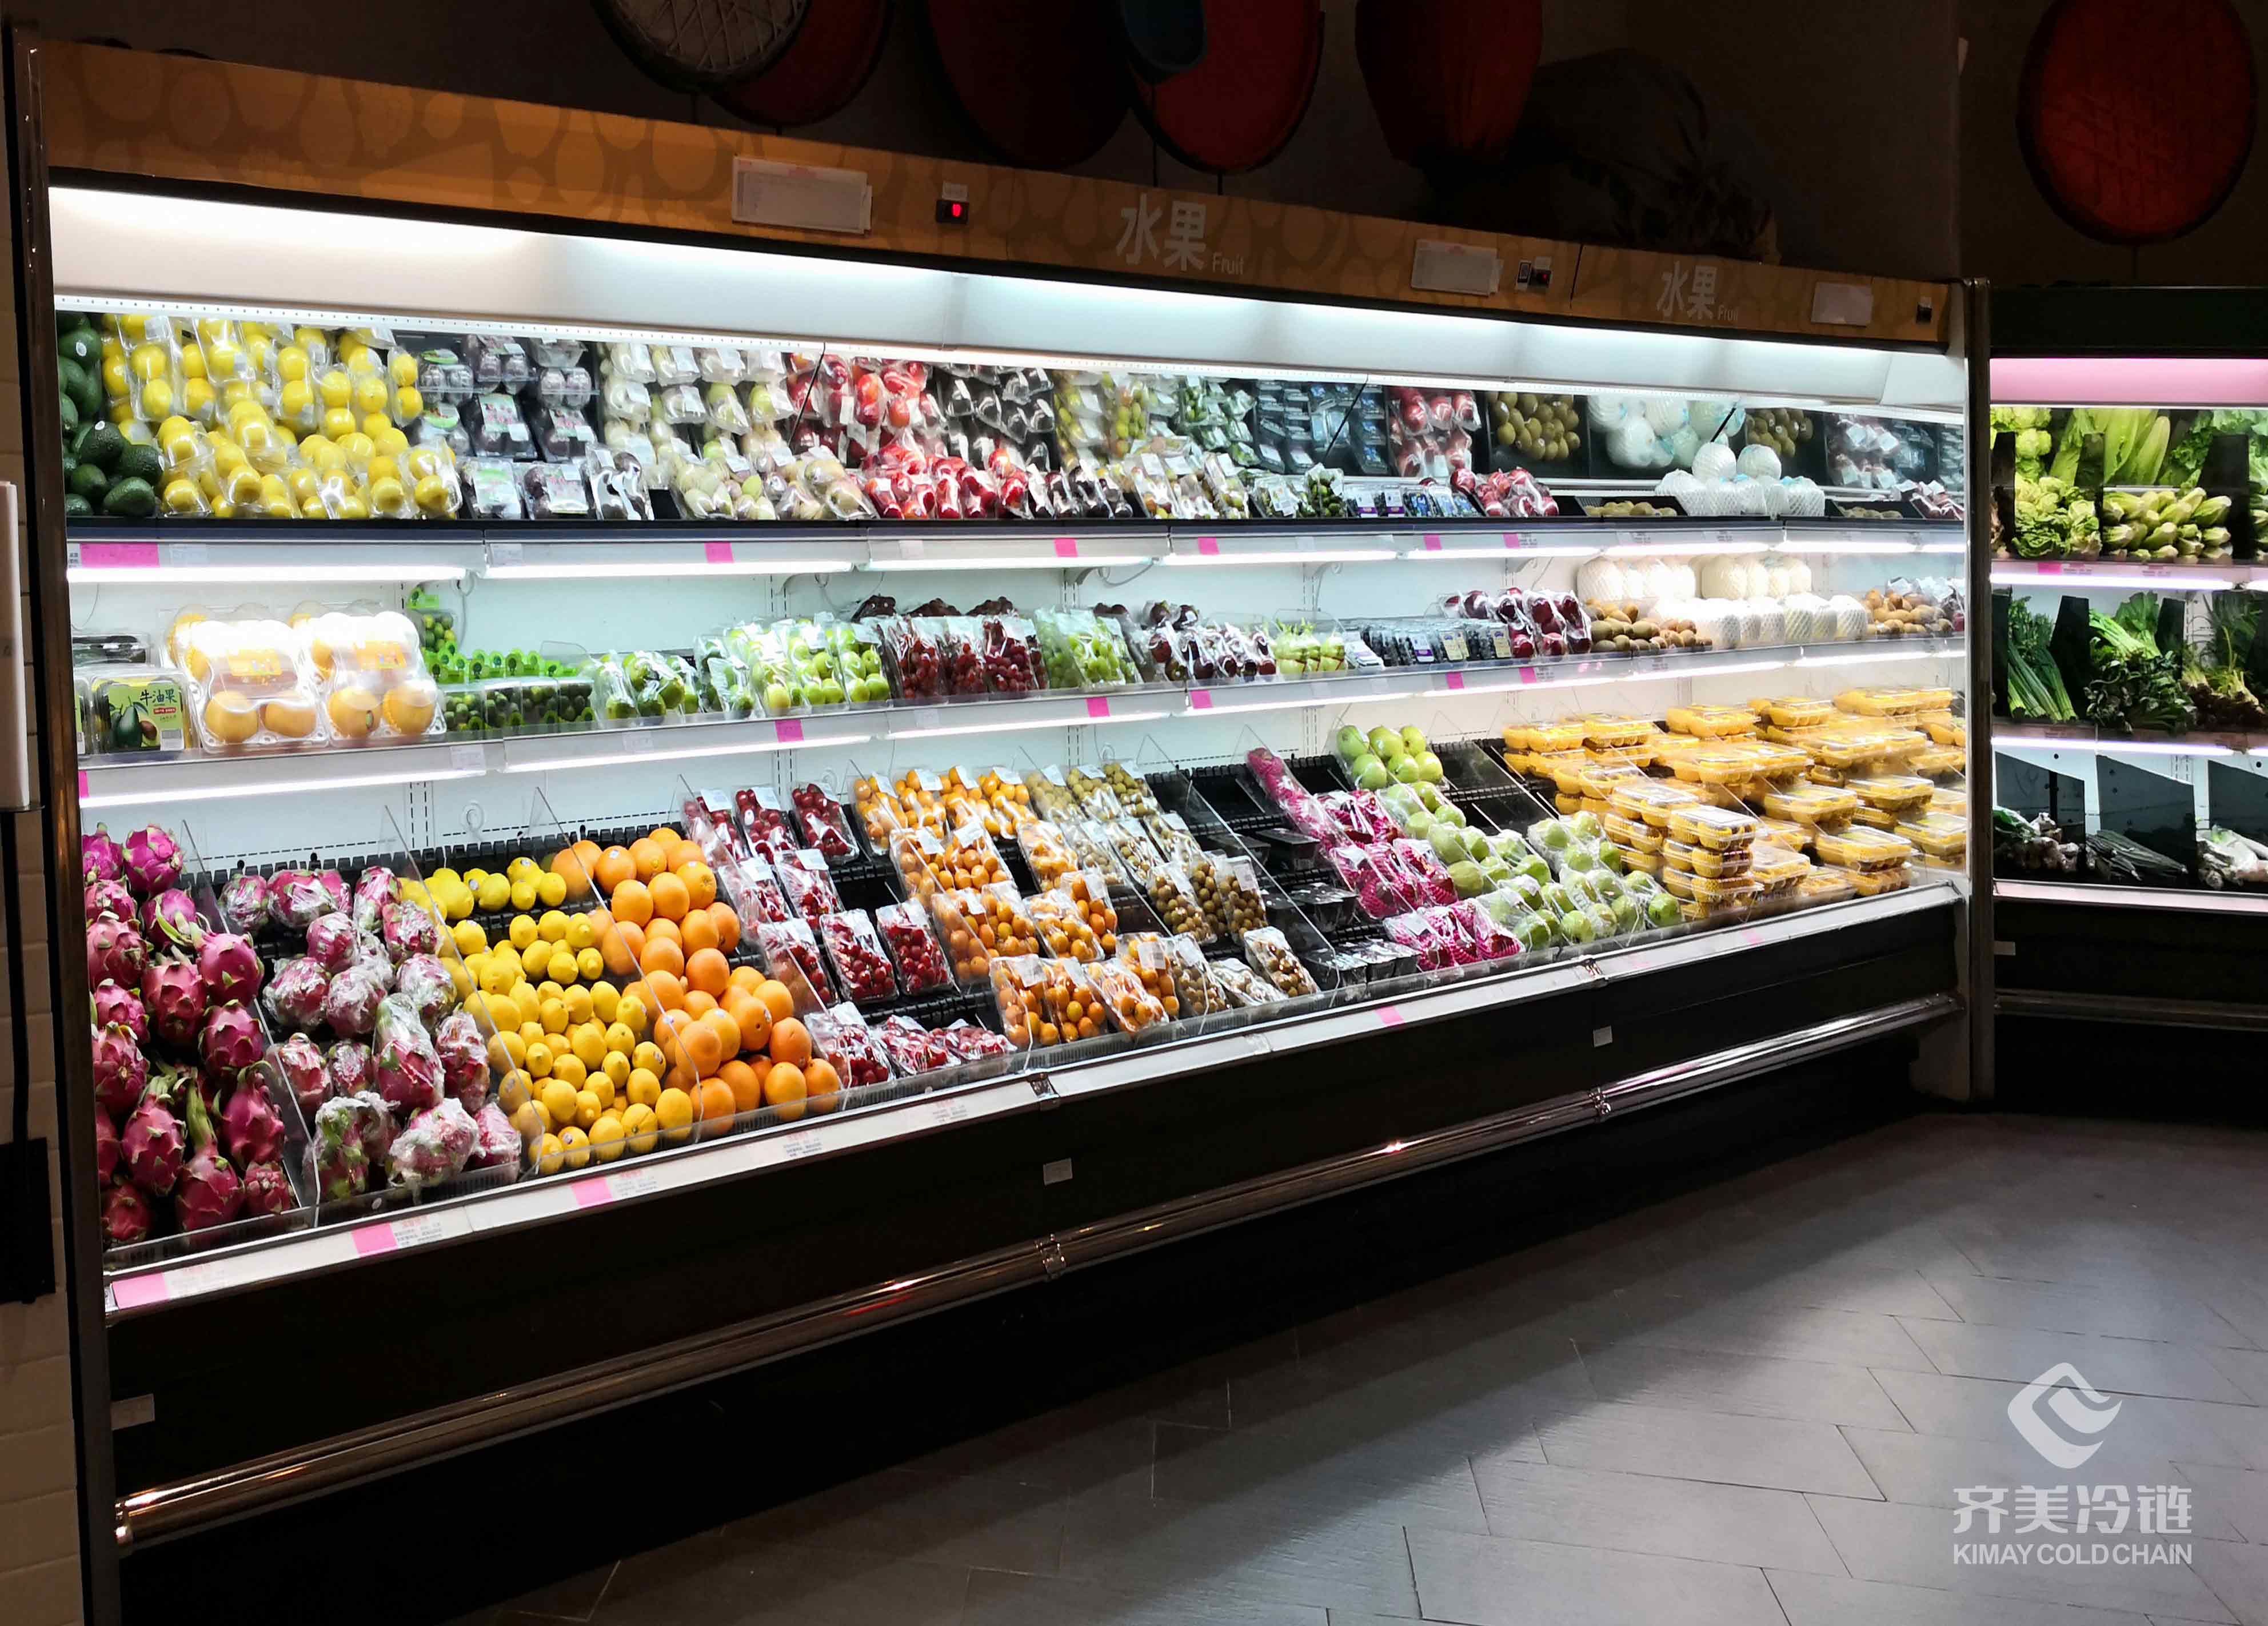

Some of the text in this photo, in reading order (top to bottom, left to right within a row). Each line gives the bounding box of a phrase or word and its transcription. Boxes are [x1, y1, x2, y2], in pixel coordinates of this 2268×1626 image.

[1116, 193, 1206, 272] 水果
[1212, 252, 1244, 275] Fruit
[1656, 260, 1718, 320] 水果
[140, 689, 177, 706] 牛油果
